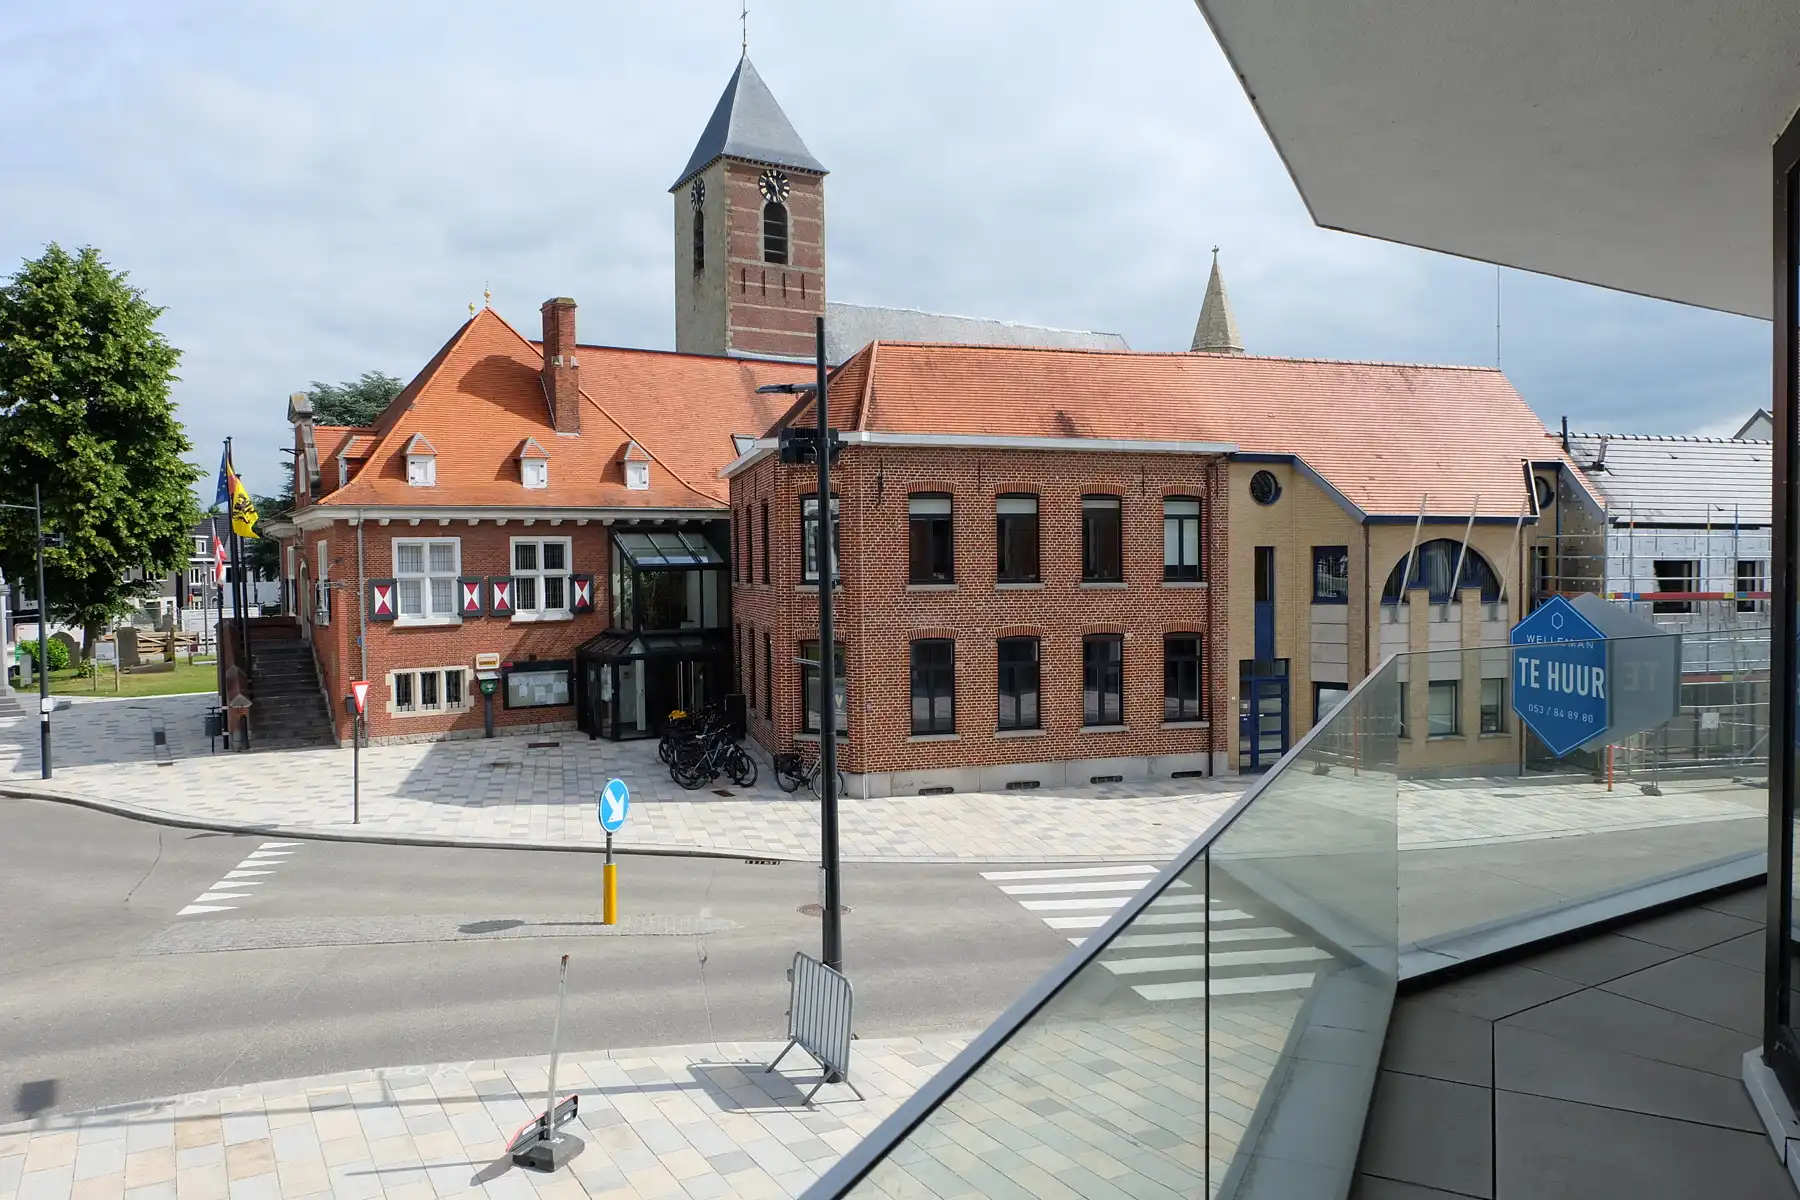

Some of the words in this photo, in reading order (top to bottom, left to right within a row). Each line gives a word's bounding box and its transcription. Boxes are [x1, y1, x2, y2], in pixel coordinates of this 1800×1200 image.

[1518, 657, 1540, 689] TE
[1547, 661, 1605, 698] HUUR
[1528, 703, 1544, 714] 053
[1553, 708, 1564, 718] 84
[1567, 710, 1579, 720] 89
[1582, 713, 1594, 724] 80
